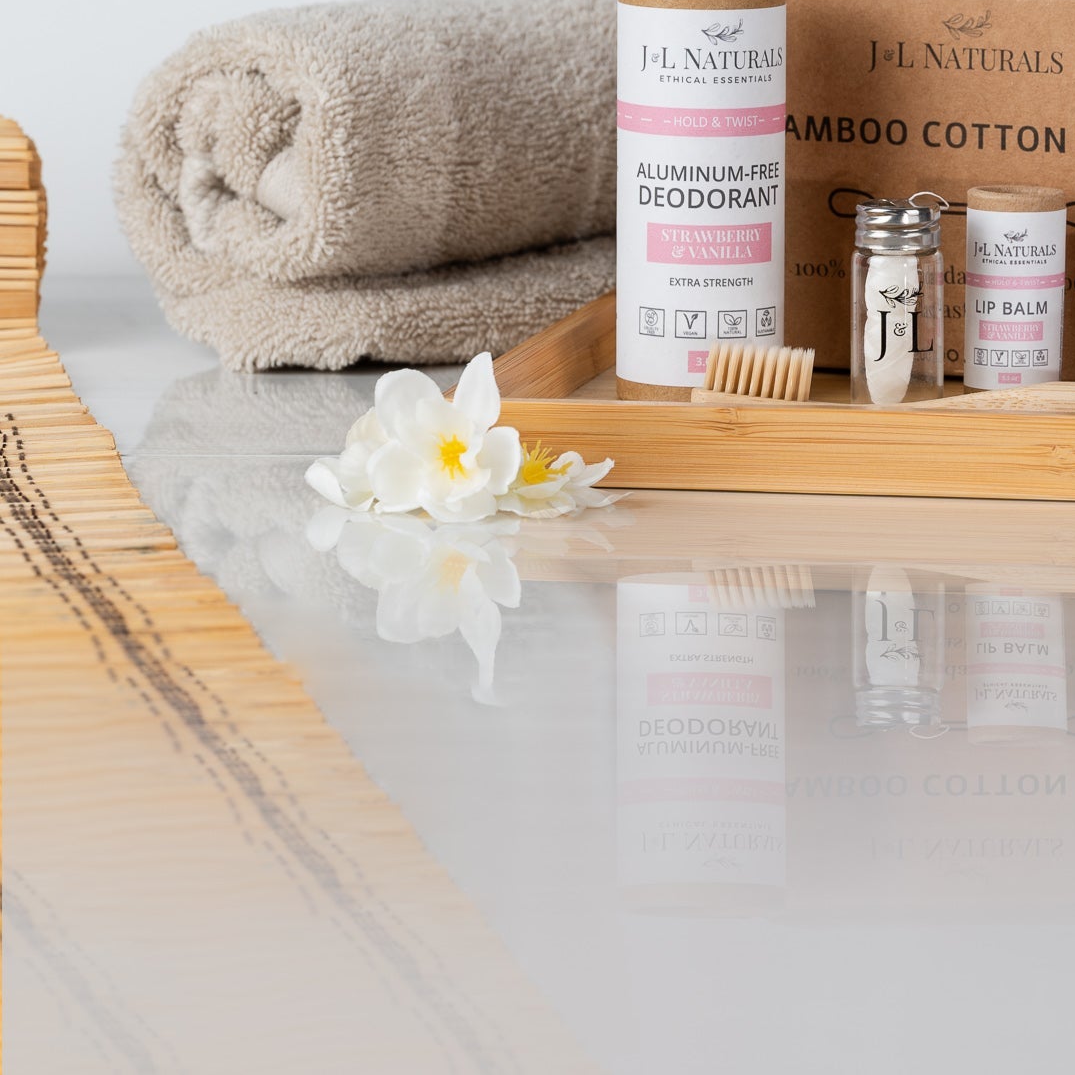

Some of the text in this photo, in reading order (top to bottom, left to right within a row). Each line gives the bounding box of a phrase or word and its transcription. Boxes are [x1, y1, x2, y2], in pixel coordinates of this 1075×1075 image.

[640, 45, 783, 72] J&L NATURALS
[868, 40, 1064, 75] J&L NATURALS
[660, 74, 772, 84] ETHICAL ESSENTIALS
[673, 115, 758, 127] HOLD & TWIST
[786, 114, 908, 146] AMBOO
[922, 121, 1066, 153] COTTON
[637, 161, 779, 182] ALUMINUM-FREE
[639, 185, 778, 209] DEODORANT
[661, 228, 761, 243] STRAWBERRY
[671, 245, 753, 259] & VANILLA
[994, 244, 1057, 258] NATURALS
[795, 258, 846, 279] 100%
[669, 277, 754, 287] EXTRA STRENGTH
[975, 299, 996, 314] LIP
[1003, 301, 1048, 316] BALM
